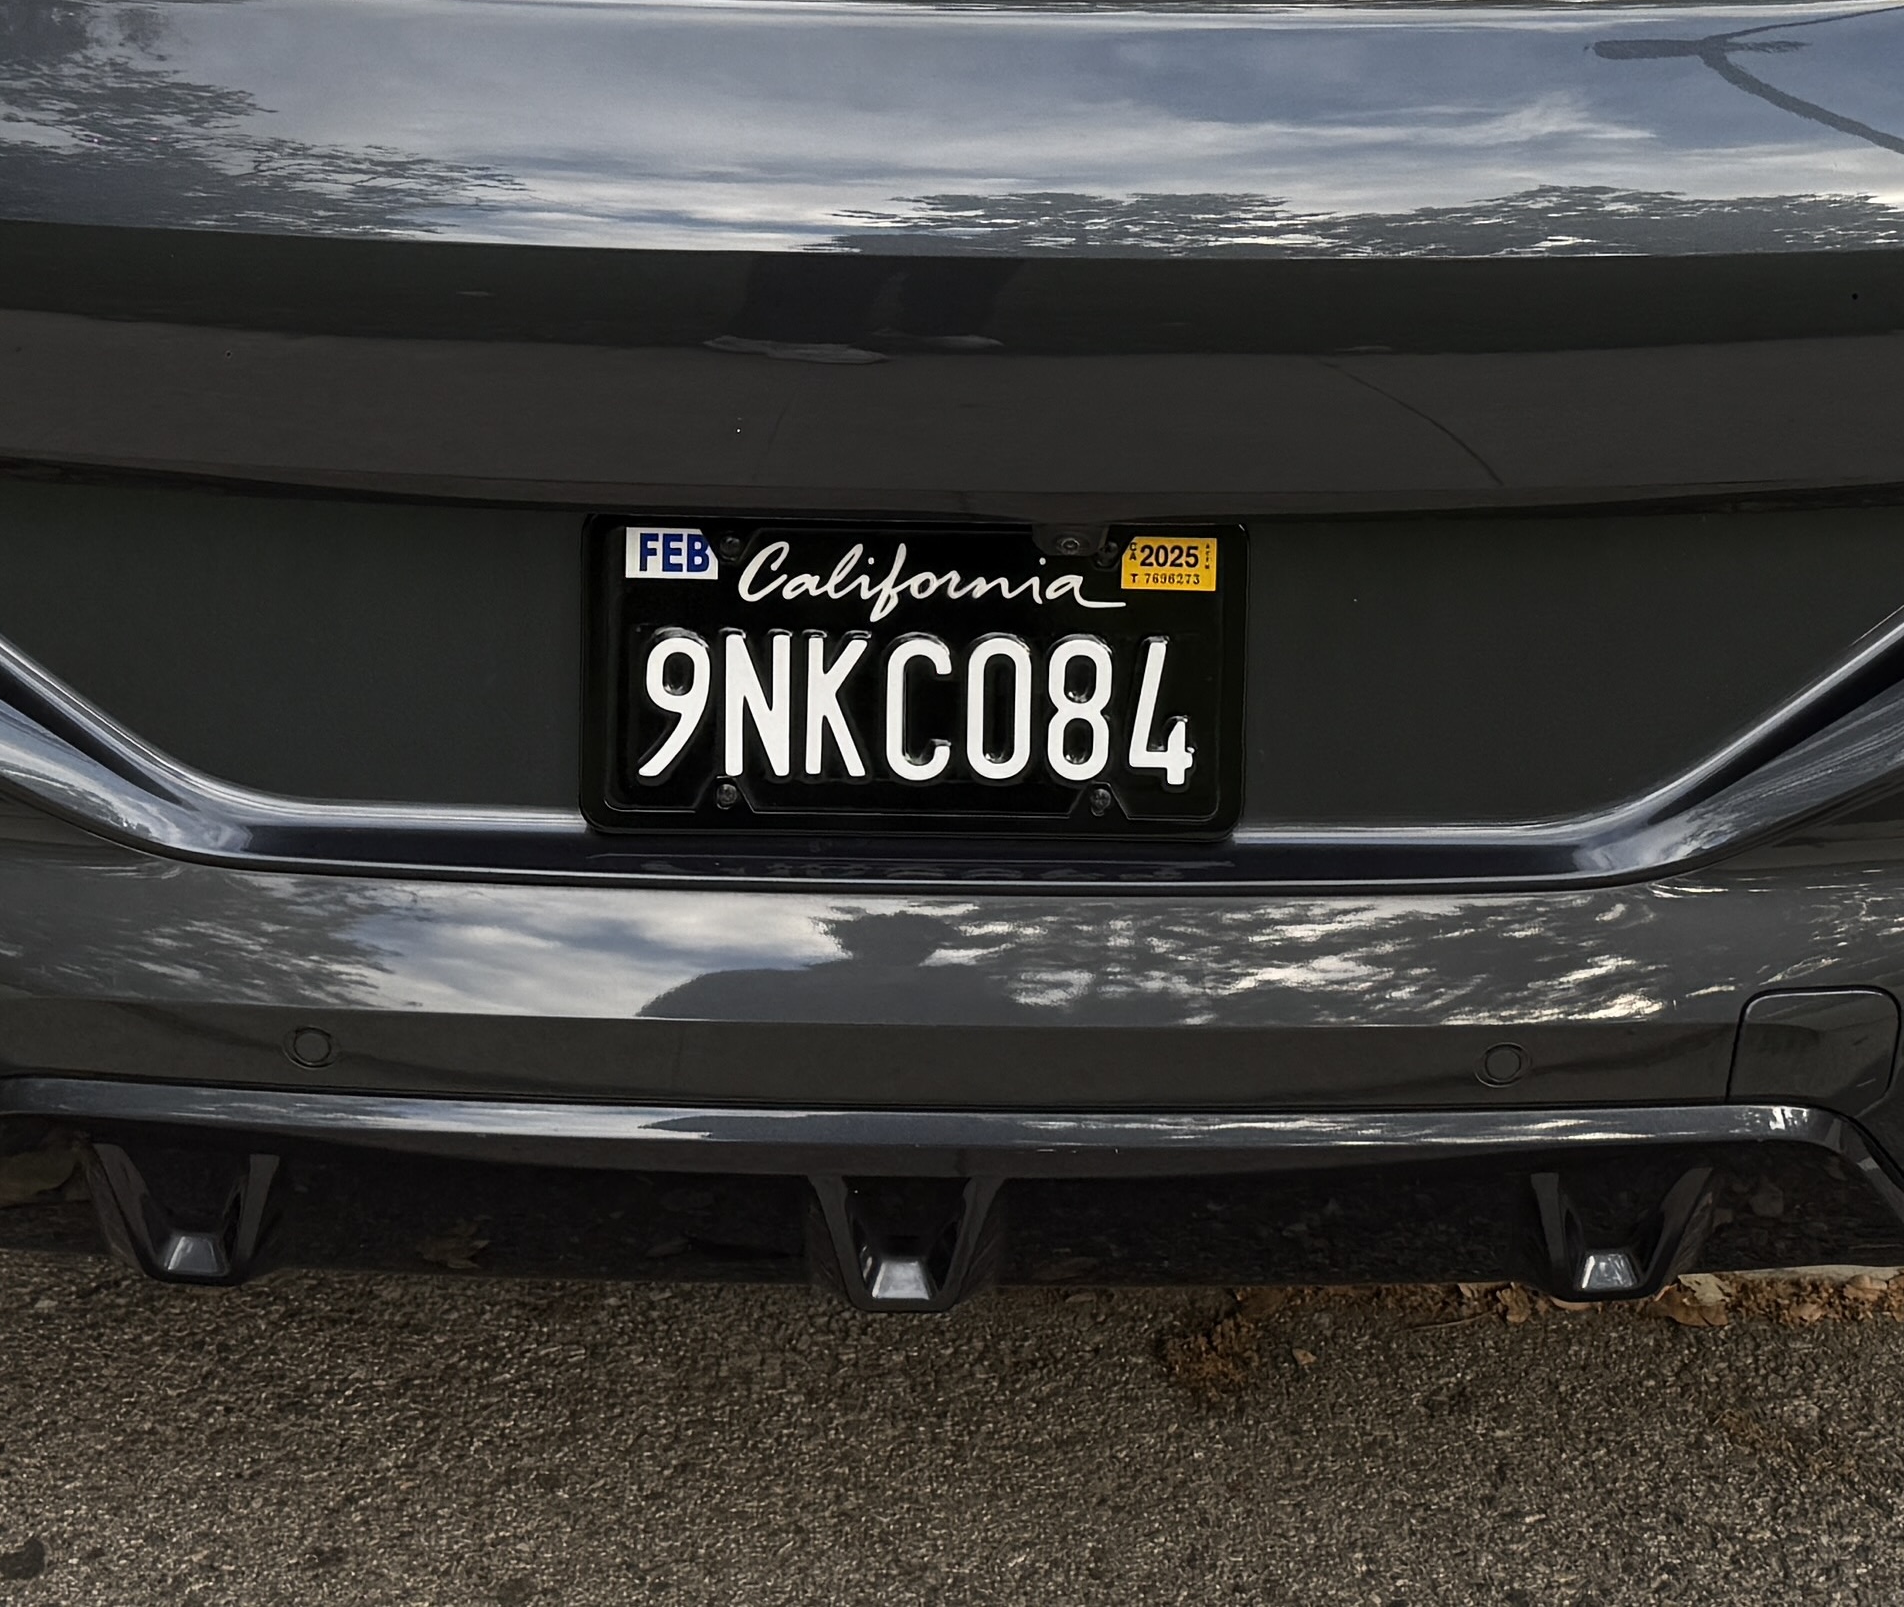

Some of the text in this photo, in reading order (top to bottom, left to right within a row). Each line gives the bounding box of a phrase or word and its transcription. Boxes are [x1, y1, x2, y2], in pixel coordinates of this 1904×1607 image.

[639, 532, 710, 572] FEB
[738, 541, 1126, 622] California
[1140, 544, 1199, 568] 2025
[638, 635, 1193, 786] 9NKC084
